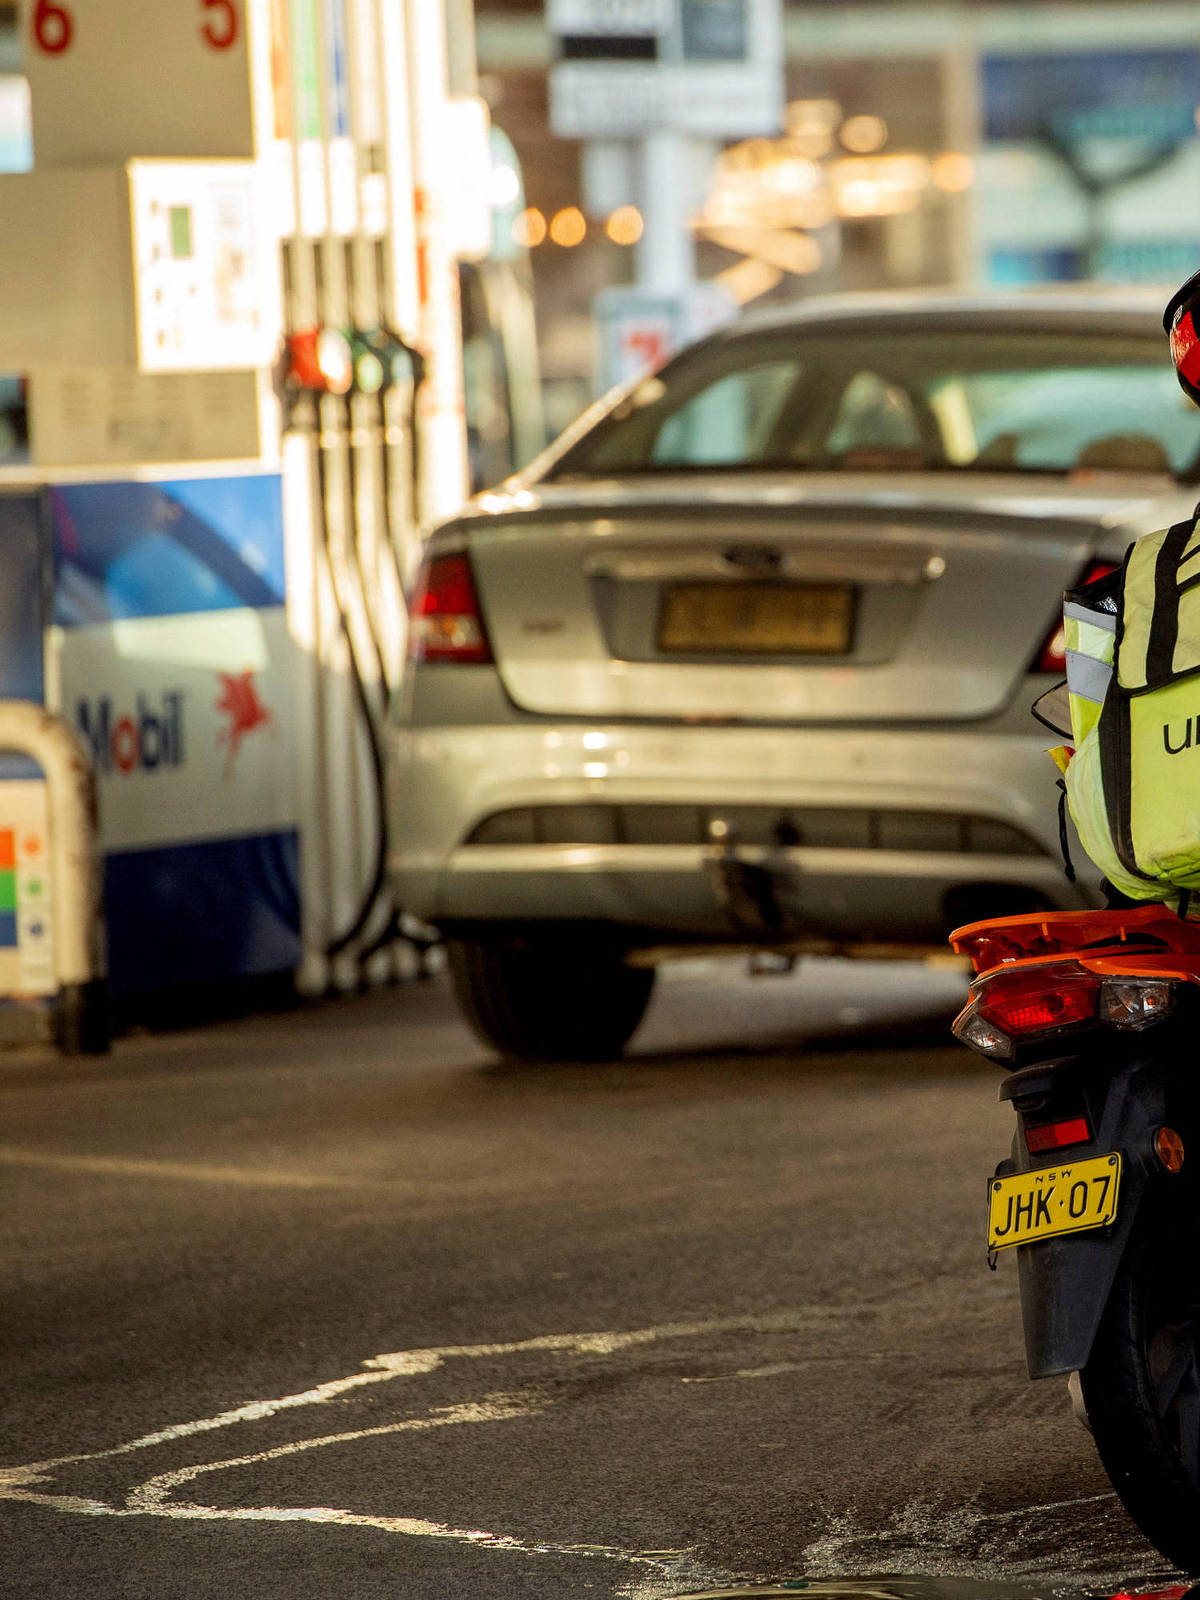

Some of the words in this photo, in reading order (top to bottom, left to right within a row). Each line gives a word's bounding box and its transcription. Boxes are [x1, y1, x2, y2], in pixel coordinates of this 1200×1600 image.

[33, 0, 73, 53] 6
[76, 688, 184, 777] Mobil
[1035, 1169, 1073, 1184] NSW
